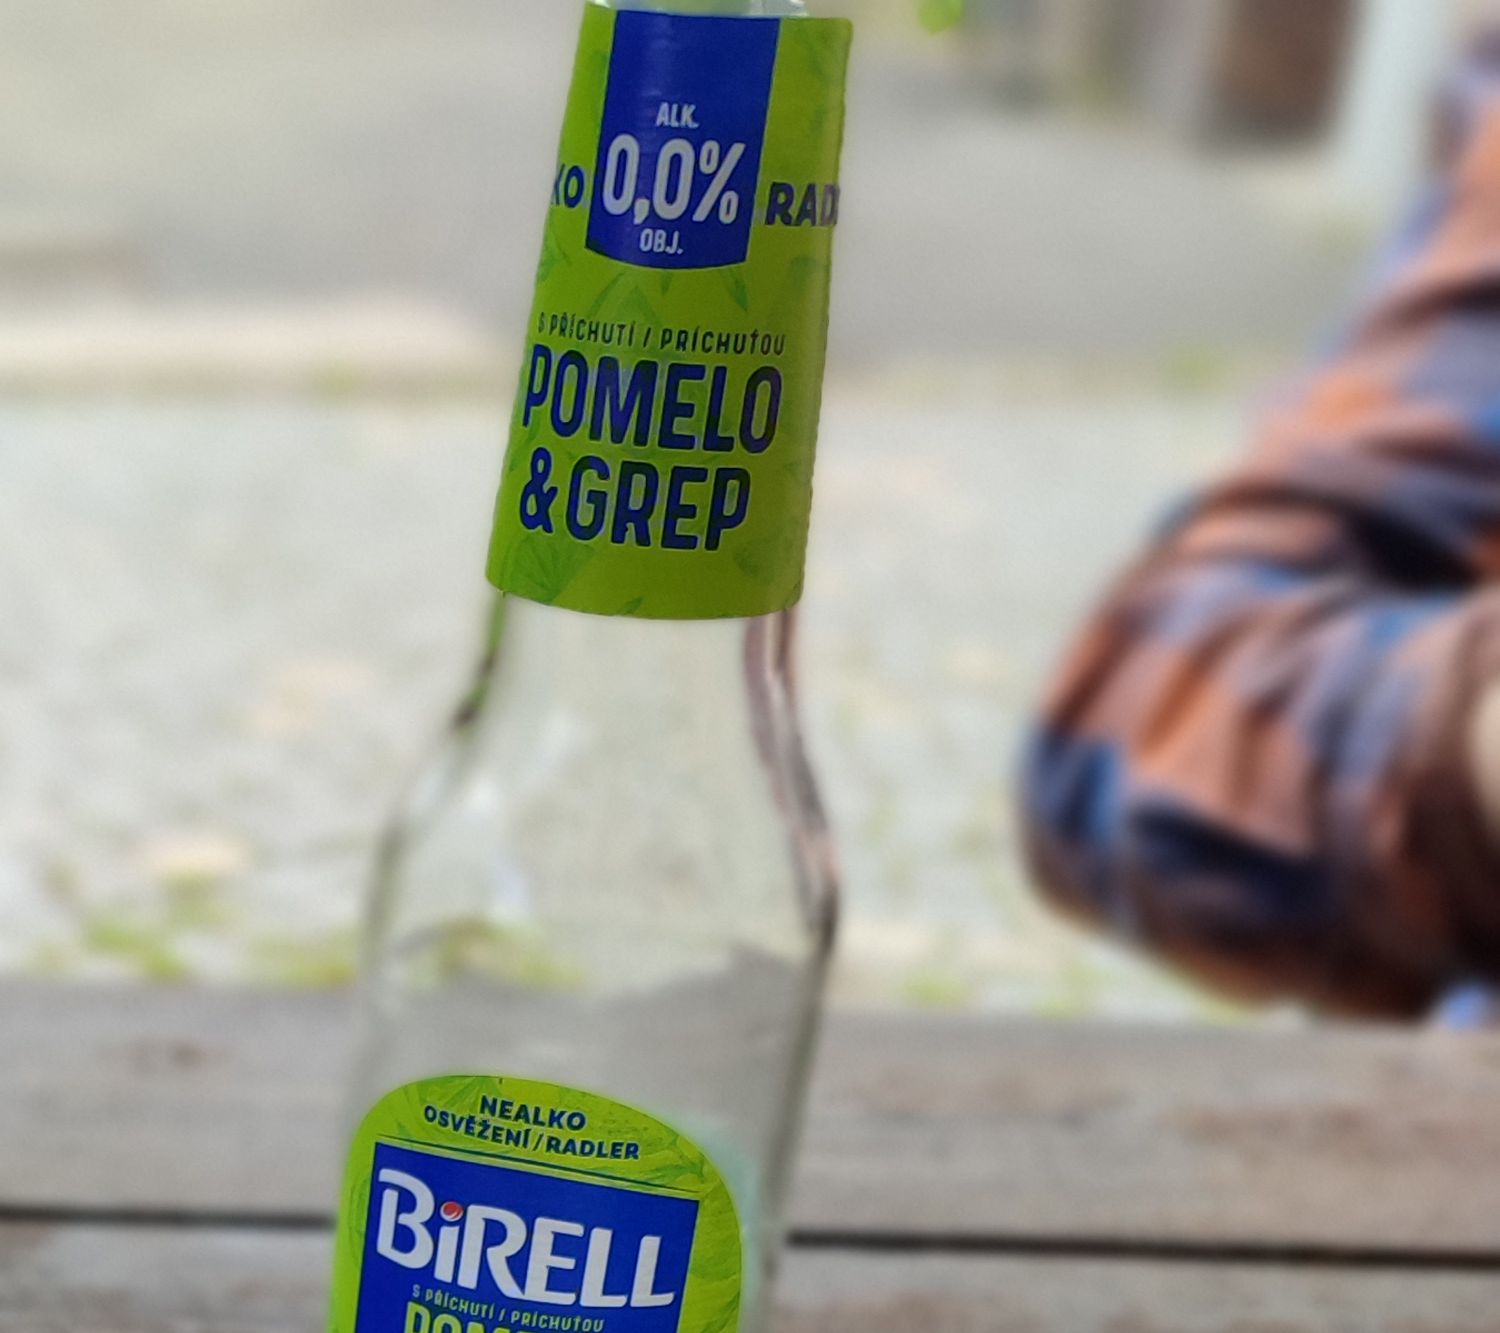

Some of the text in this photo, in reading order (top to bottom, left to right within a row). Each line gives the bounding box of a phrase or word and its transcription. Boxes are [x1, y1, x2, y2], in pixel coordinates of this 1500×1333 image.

[654, 101, 700, 129] ALK.
[602, 133, 747, 225] 0,0%
[638, 227, 684, 256] OBJ.
[537, 311, 546, 334] S
[522, 343, 783, 454] POMELO
[478, 1094, 588, 1132] NEALKO
